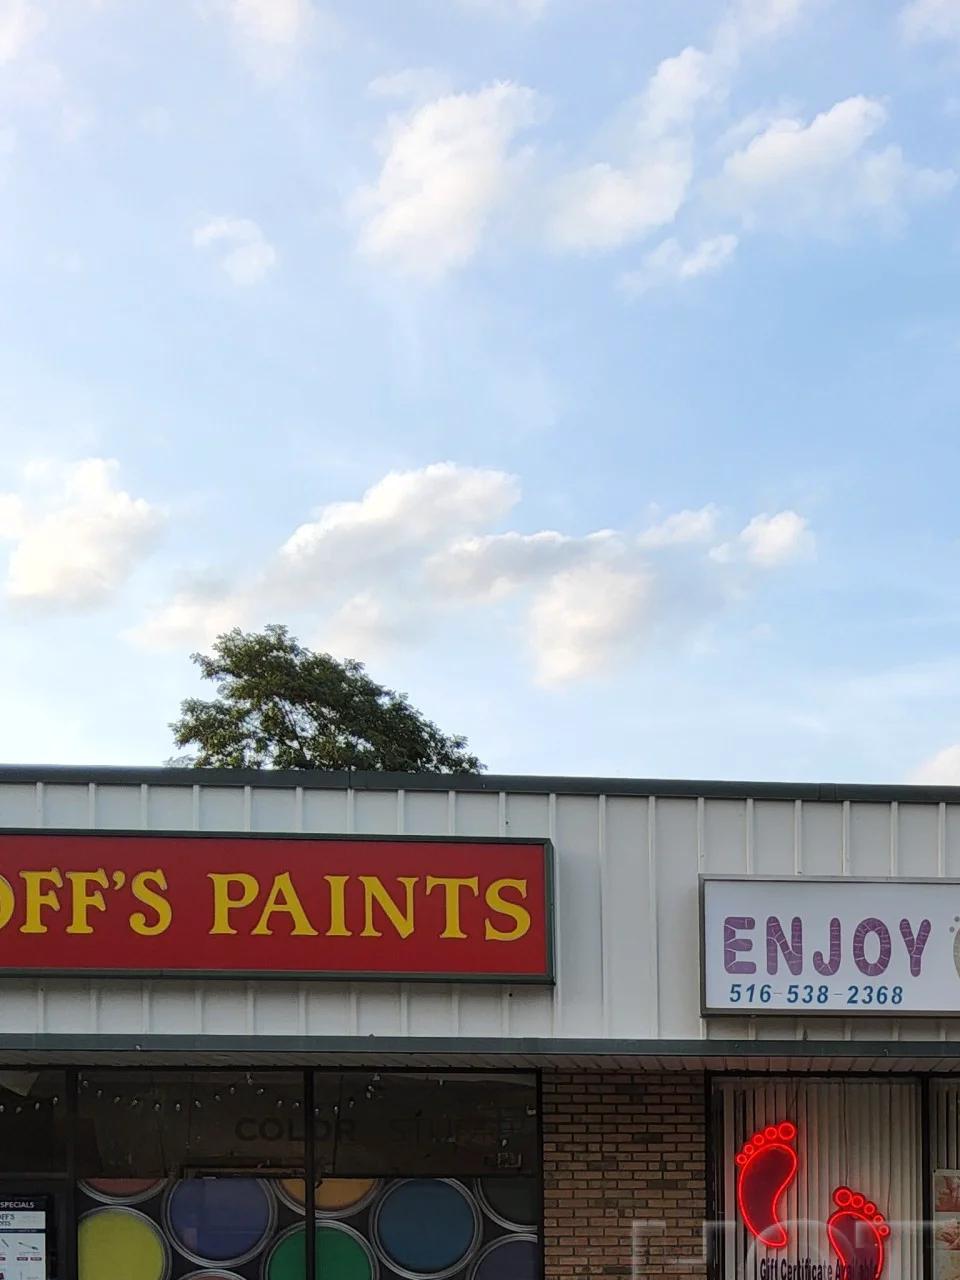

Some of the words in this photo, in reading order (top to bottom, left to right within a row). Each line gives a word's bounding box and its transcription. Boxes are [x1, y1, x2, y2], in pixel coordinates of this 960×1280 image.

[0, 867, 172, 936] FF'S
[207, 872, 531, 942] PAINTS
[724, 916, 931, 977] ENJOY
